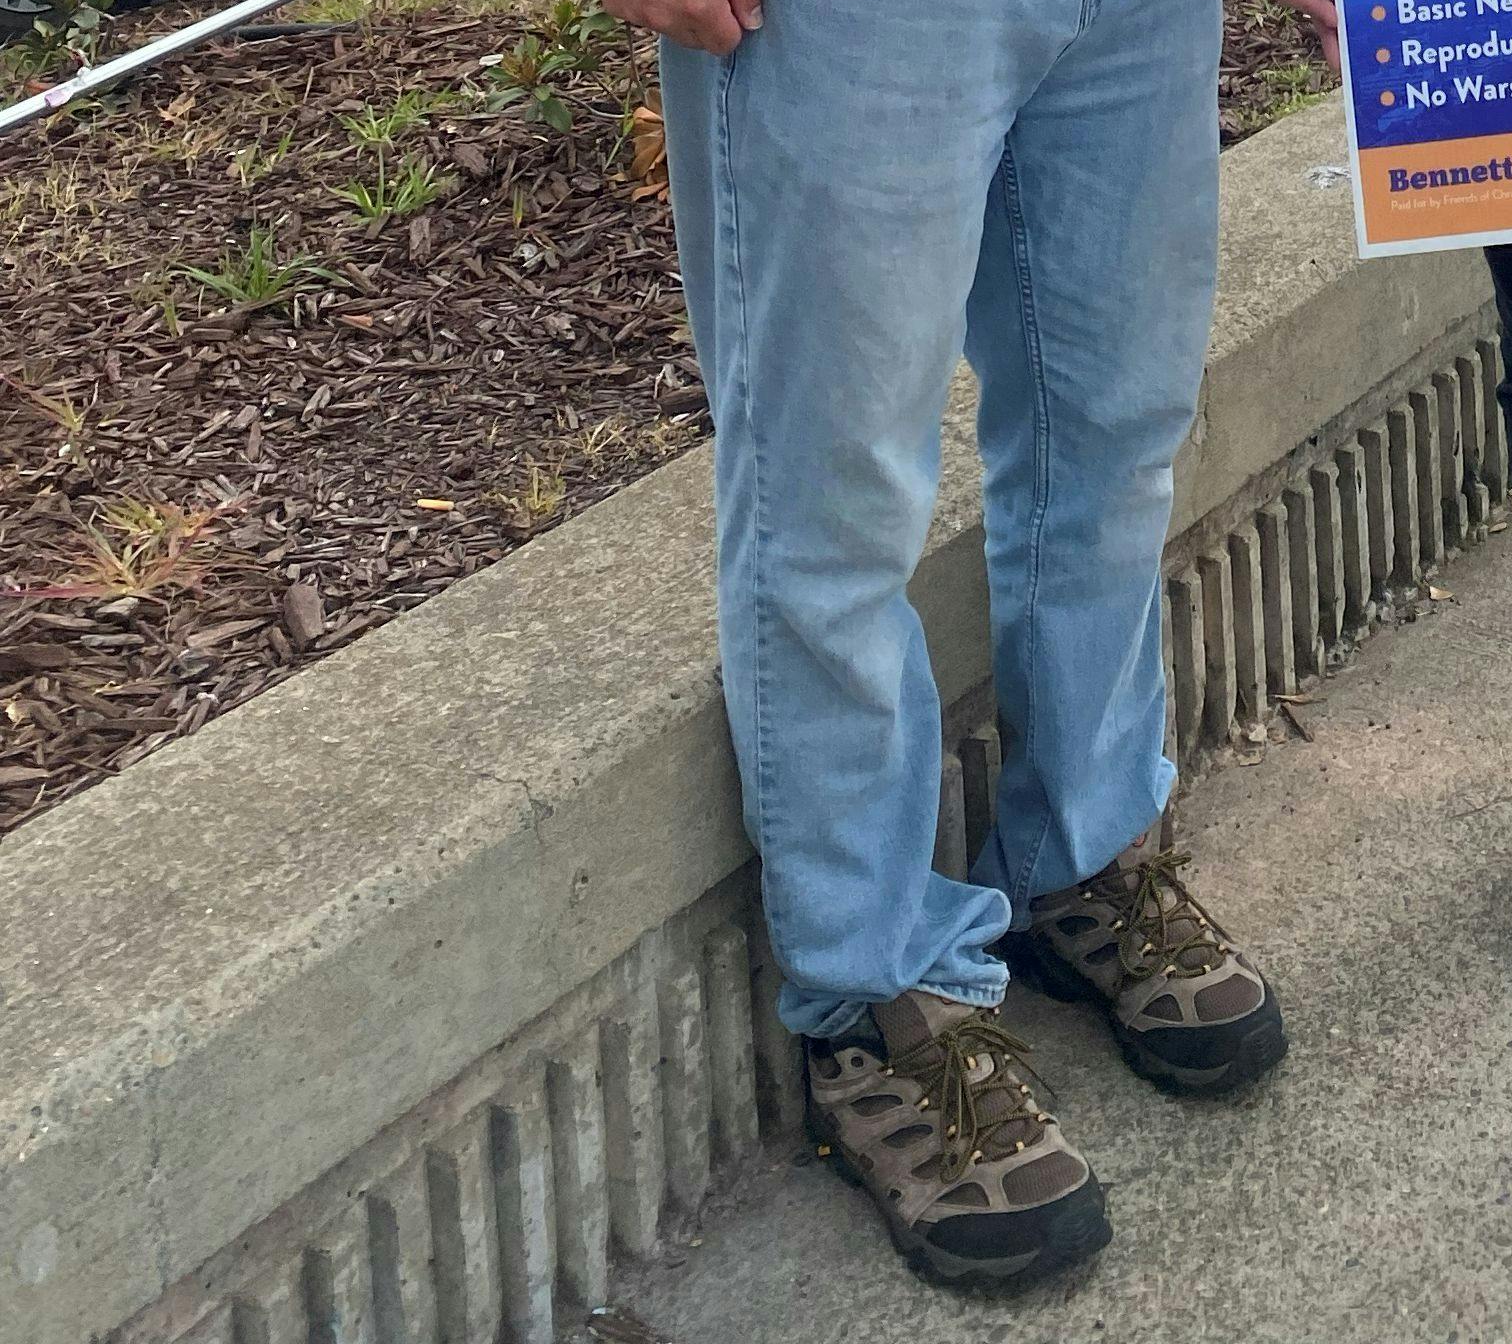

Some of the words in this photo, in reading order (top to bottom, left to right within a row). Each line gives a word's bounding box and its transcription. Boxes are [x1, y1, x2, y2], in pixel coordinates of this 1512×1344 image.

[1406, 82, 1446, 109] No
[1391, 200, 1411, 211] Paid
[1414, 198, 1426, 208] for
[1429, 197, 1441, 209] by
[1444, 193, 1478, 205] Friends
[1480, 191, 1490, 201] of
